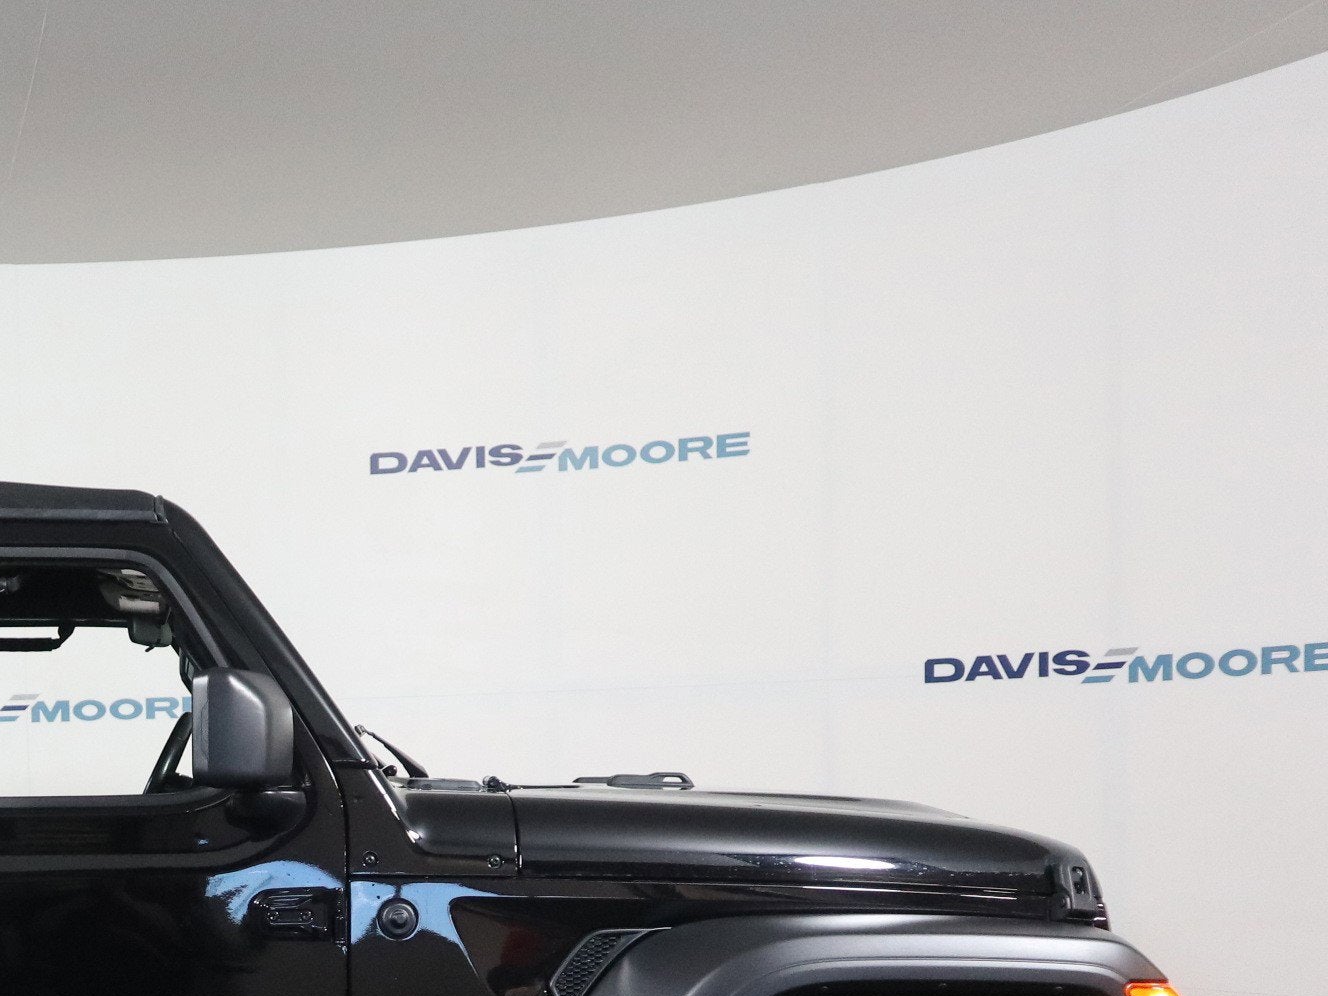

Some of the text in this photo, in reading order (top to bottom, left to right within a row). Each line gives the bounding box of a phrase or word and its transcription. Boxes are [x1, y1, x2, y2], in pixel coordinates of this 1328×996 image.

[369, 431, 751, 475] DAVIS MOORE
[924, 641, 1328, 684] DAVIS MOORE
